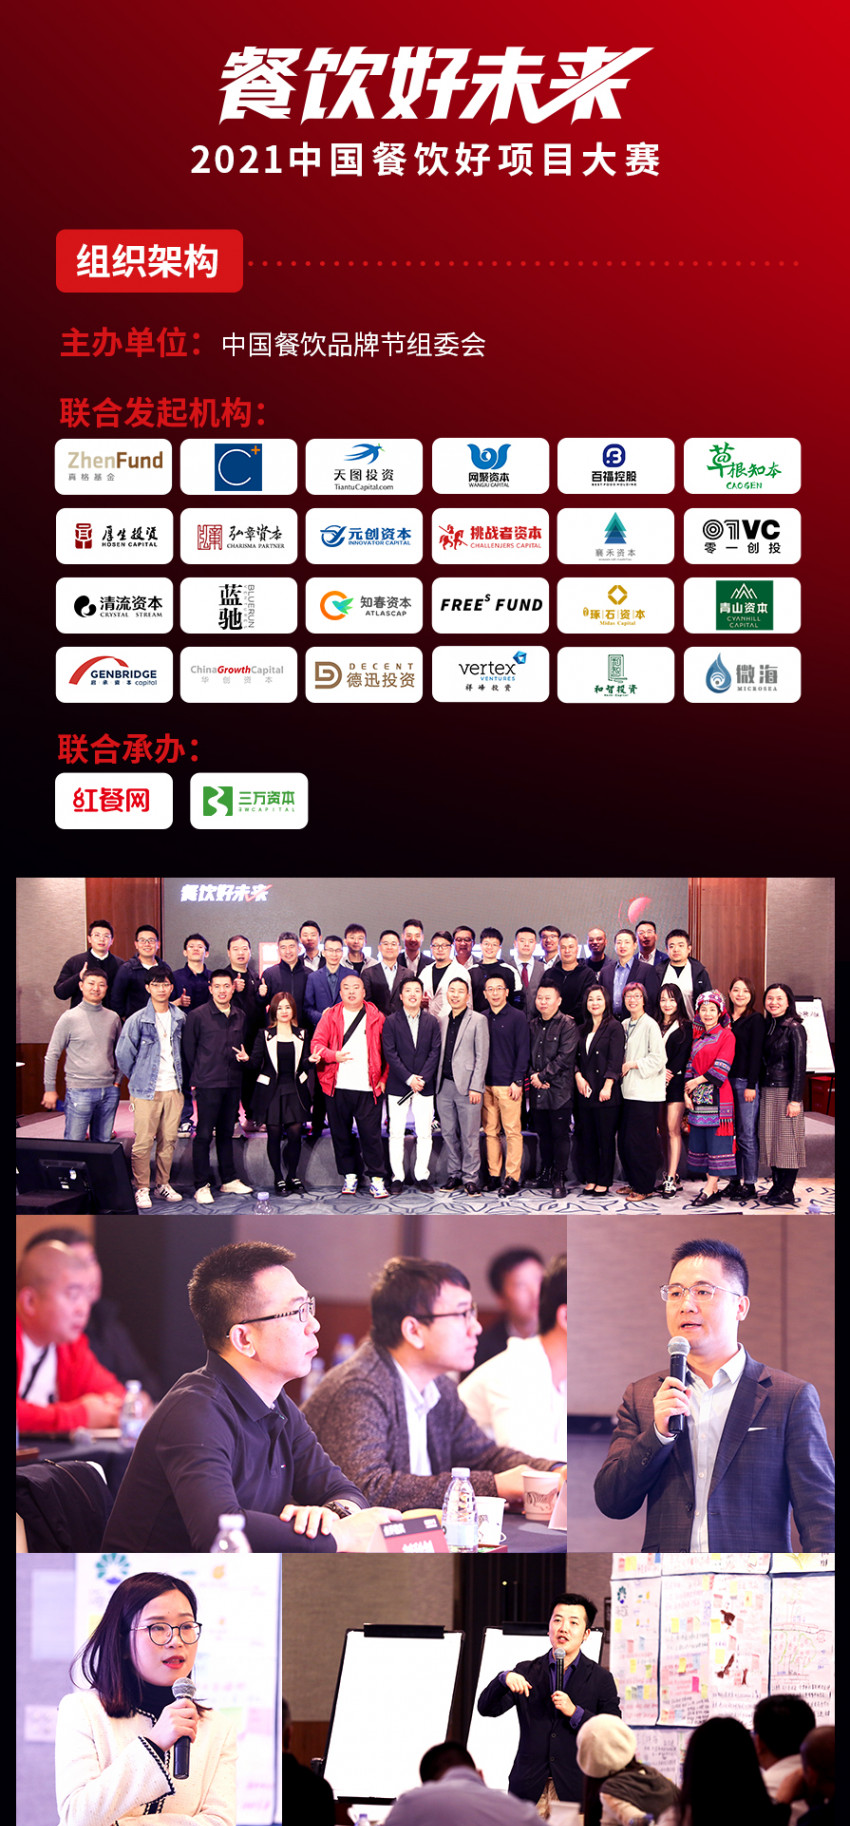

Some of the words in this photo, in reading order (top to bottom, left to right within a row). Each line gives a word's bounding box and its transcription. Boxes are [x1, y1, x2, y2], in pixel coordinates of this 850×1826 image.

[219, 46, 654, 125] 餐饮好未来
[191, 141, 659, 177] 2021中国餐饮好项目大赛
[77, 243, 218, 278] 组织架构
[61, 326, 200, 358] 主办单位：
[223, 331, 485, 357] 中国餐饮品牌节组委会
[60, 397, 264, 428] 联合发起机构：
[69, 451, 163, 468] ZhenFund
[707, 442, 782, 478] 草根知本
[334, 469, 393, 481] 天图投资
[592, 471, 636, 482] 百福控股
[349, 528, 411, 540] 元创资本
[470, 526, 542, 540] 挑战者资本
[703, 519, 780, 540] 01VC
[705, 542, 781, 554] 零一创投
[100, 596, 163, 611] 清流资本
[218, 583, 243, 630] 蓝驰
[247, 584, 256, 628] BLUERUN
[361, 596, 411, 609] 知春资本
[495, 599, 542, 611] FUND
[719, 602, 768, 614] 青山资本
[90, 669, 157, 679] GENBRIDGE
[191, 665, 283, 675] ChinaGrowthCapital
[458, 661, 516, 675] vertex
[736, 664, 778, 684] 微海
[347, 672, 415, 688] 德迅投资
[58, 733, 198, 764] 联合承办：
[73, 787, 149, 812] 红餐网
[239, 791, 295, 805] 三万资本
[179, 883, 272, 902] 餐饮好未来
